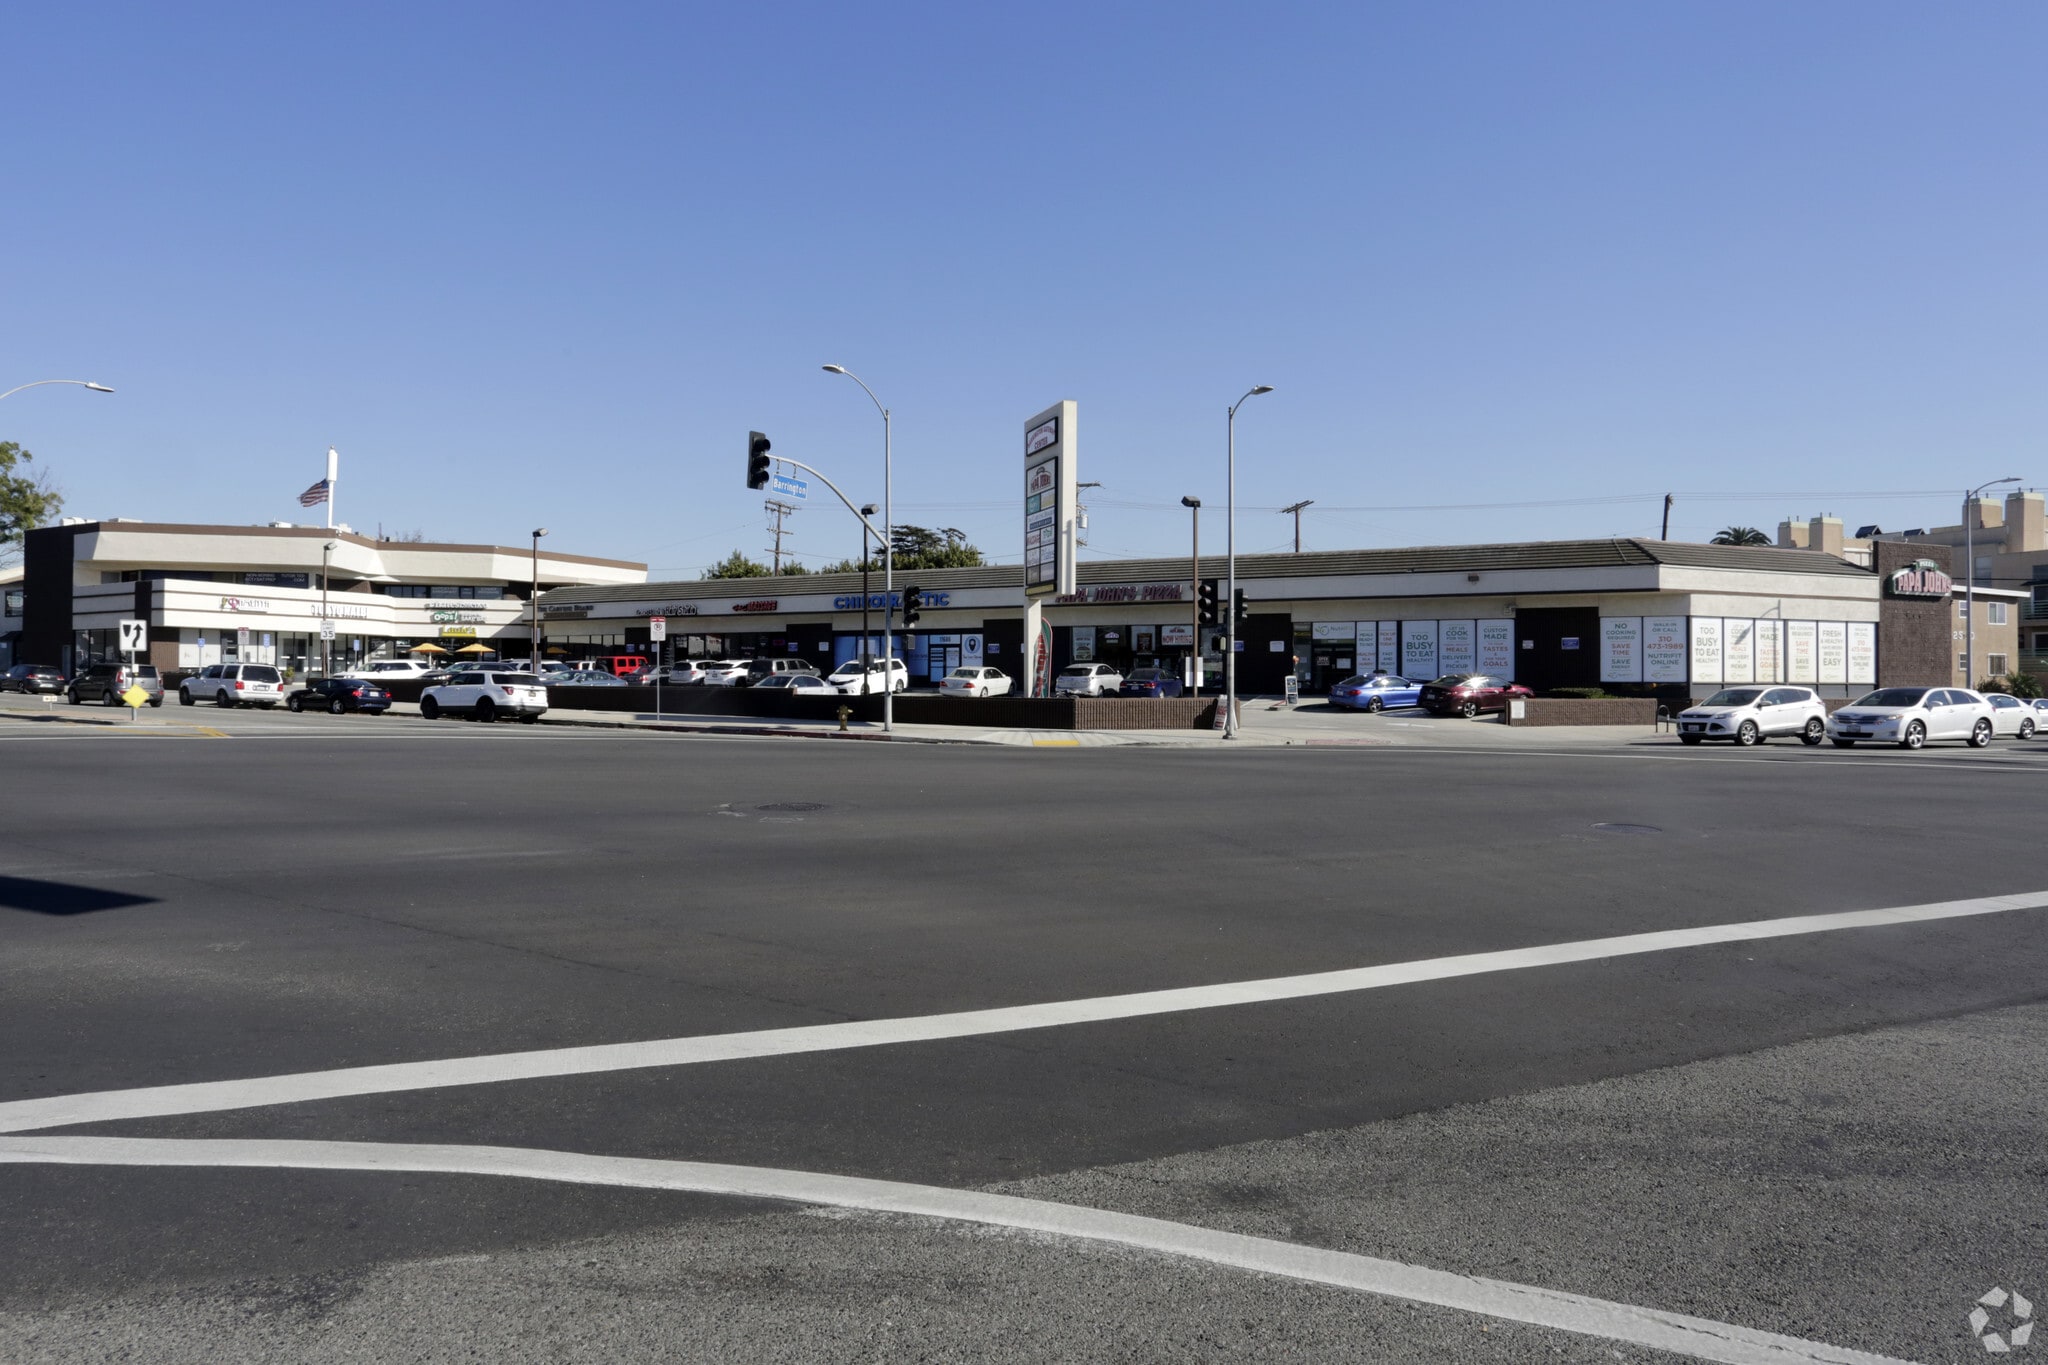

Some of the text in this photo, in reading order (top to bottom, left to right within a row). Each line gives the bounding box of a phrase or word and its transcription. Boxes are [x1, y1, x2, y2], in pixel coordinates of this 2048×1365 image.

[774, 478, 806, 496] Barrington
[1898, 571, 1922, 592] PAPA
[1093, 586, 1138, 602] JOHN'S
[1141, 584, 1182, 600] PIZZA
[1696, 638, 1718, 646] BUSY
[1695, 648, 1719, 656] TO EAT
